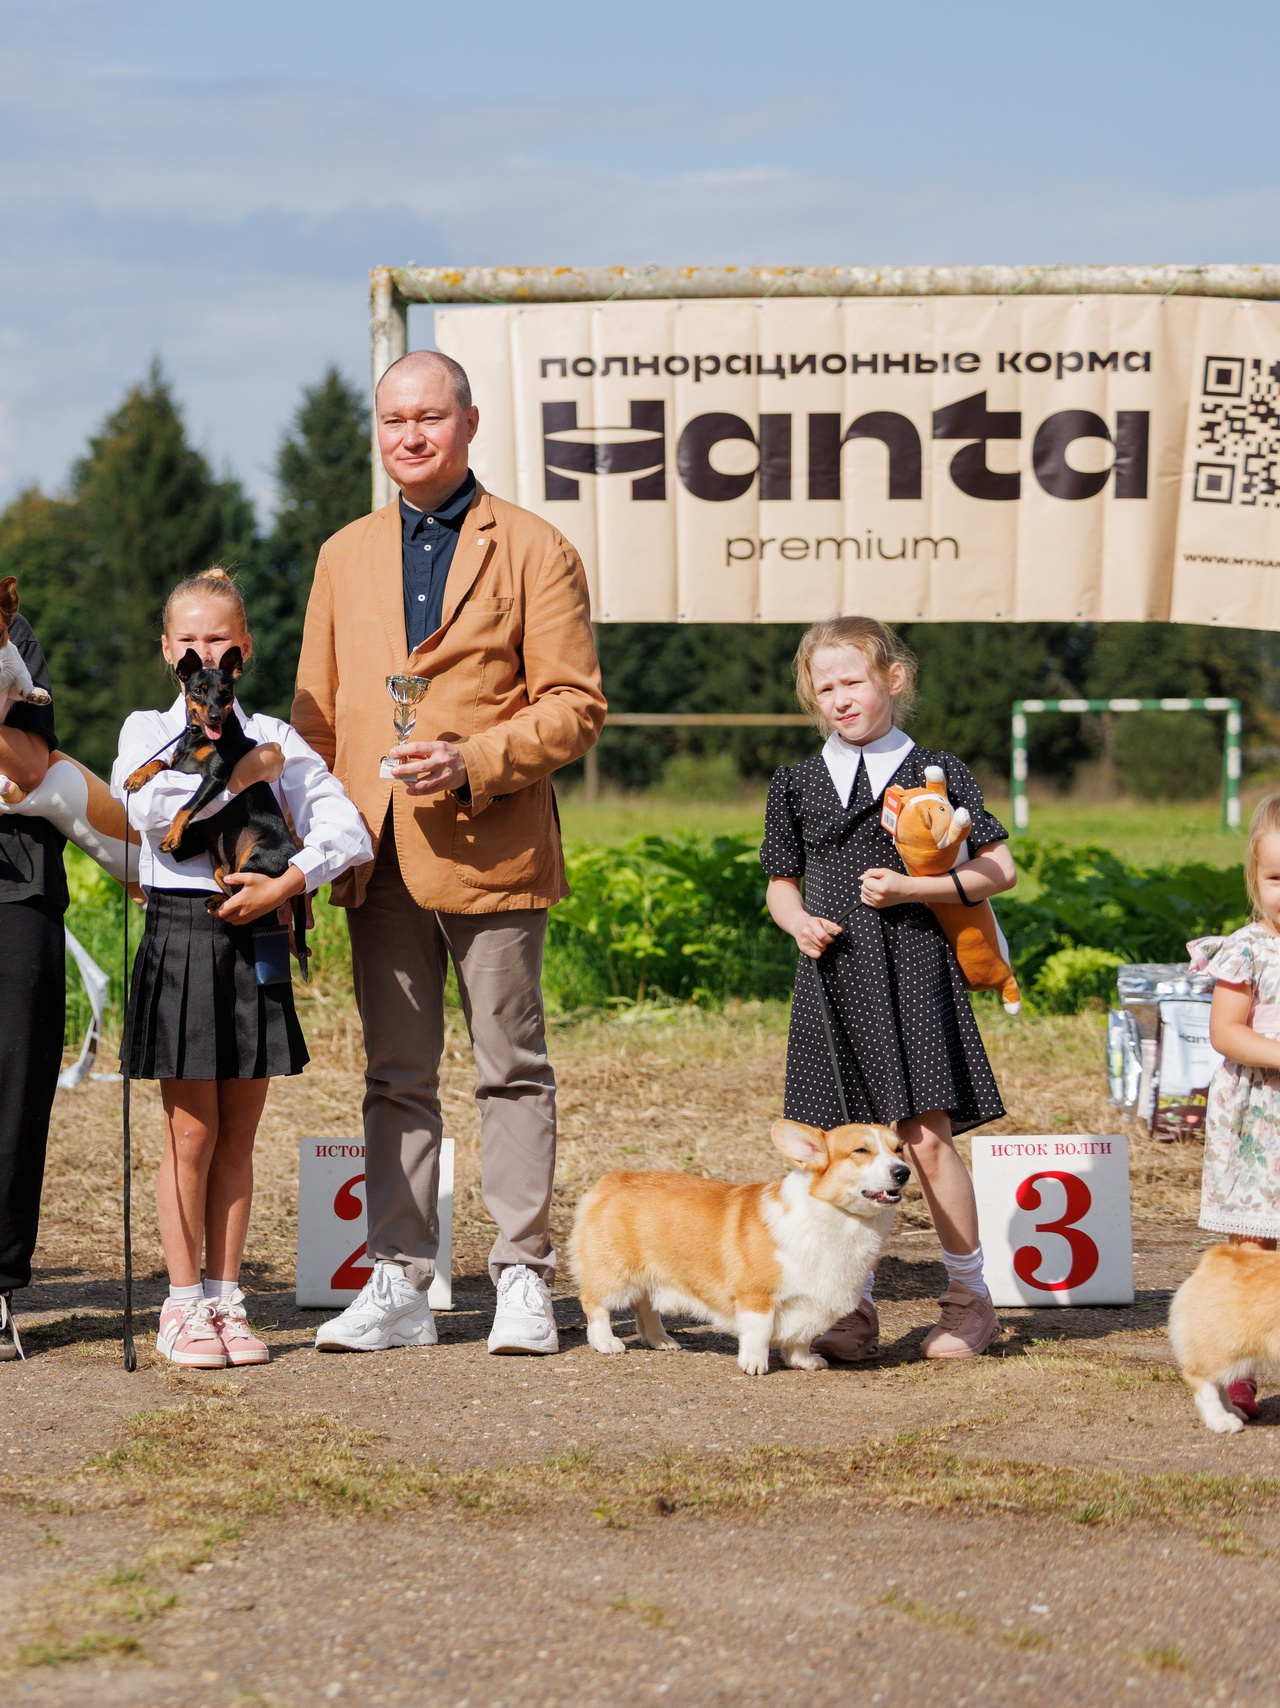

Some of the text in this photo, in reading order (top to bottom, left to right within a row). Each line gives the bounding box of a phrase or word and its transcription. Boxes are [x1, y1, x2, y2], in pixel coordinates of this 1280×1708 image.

[540, 350, 1152, 382] полнорационные корма
[541, 389, 1151, 502] Hanta
[725, 529, 960, 568] premium
[991, 1142, 1112, 1157] ИСТОК ВОЛГИ
[1013, 1170, 1099, 1291] 3
